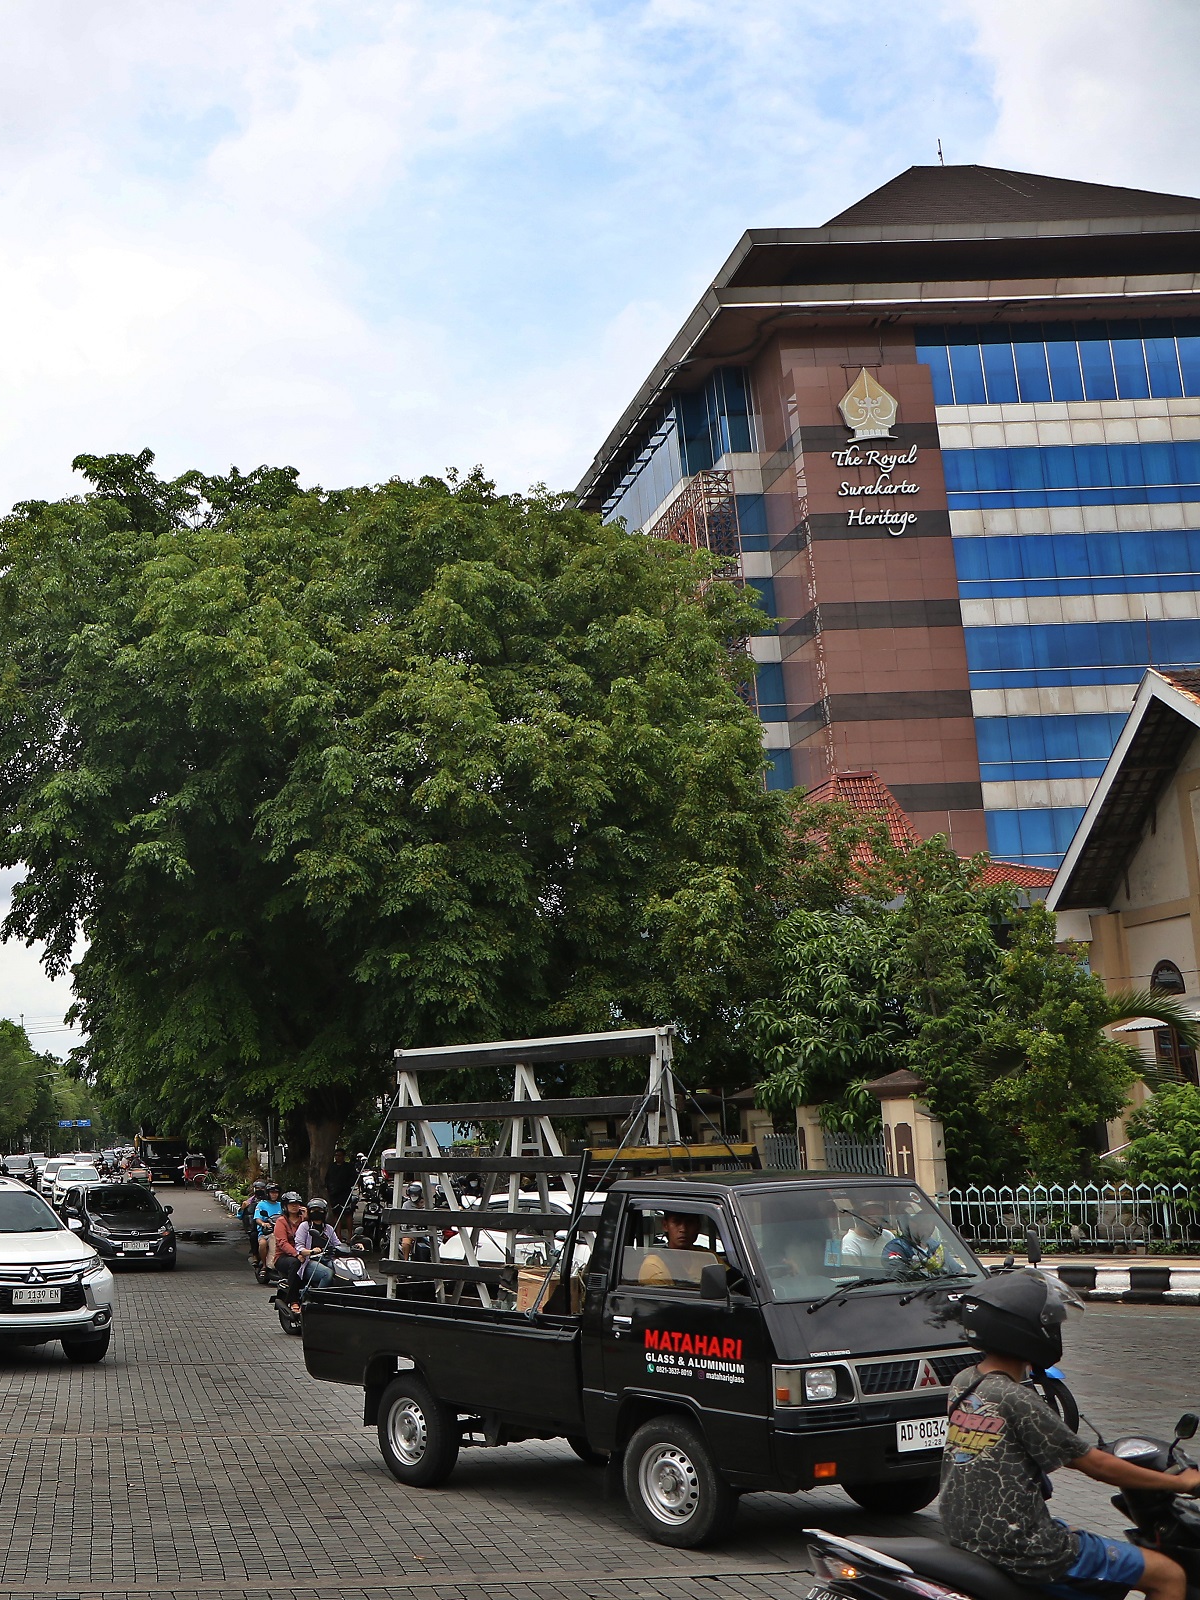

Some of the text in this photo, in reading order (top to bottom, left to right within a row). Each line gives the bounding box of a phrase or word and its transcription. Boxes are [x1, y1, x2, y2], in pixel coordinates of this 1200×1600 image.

[831, 444, 917, 473] The Royal
[838, 473, 920, 496] Surakarta
[847, 507, 918, 536] Heritage
[14, 1289, 59, 1300] AD 1139 EN
[645, 1329, 742, 1359] MATAHARI
[645, 1352, 744, 1373] GLASS & ALUMINIUM
[706, 1372, 745, 1384] matahariglass
[900, 1420, 946, 1442] AD 8034
